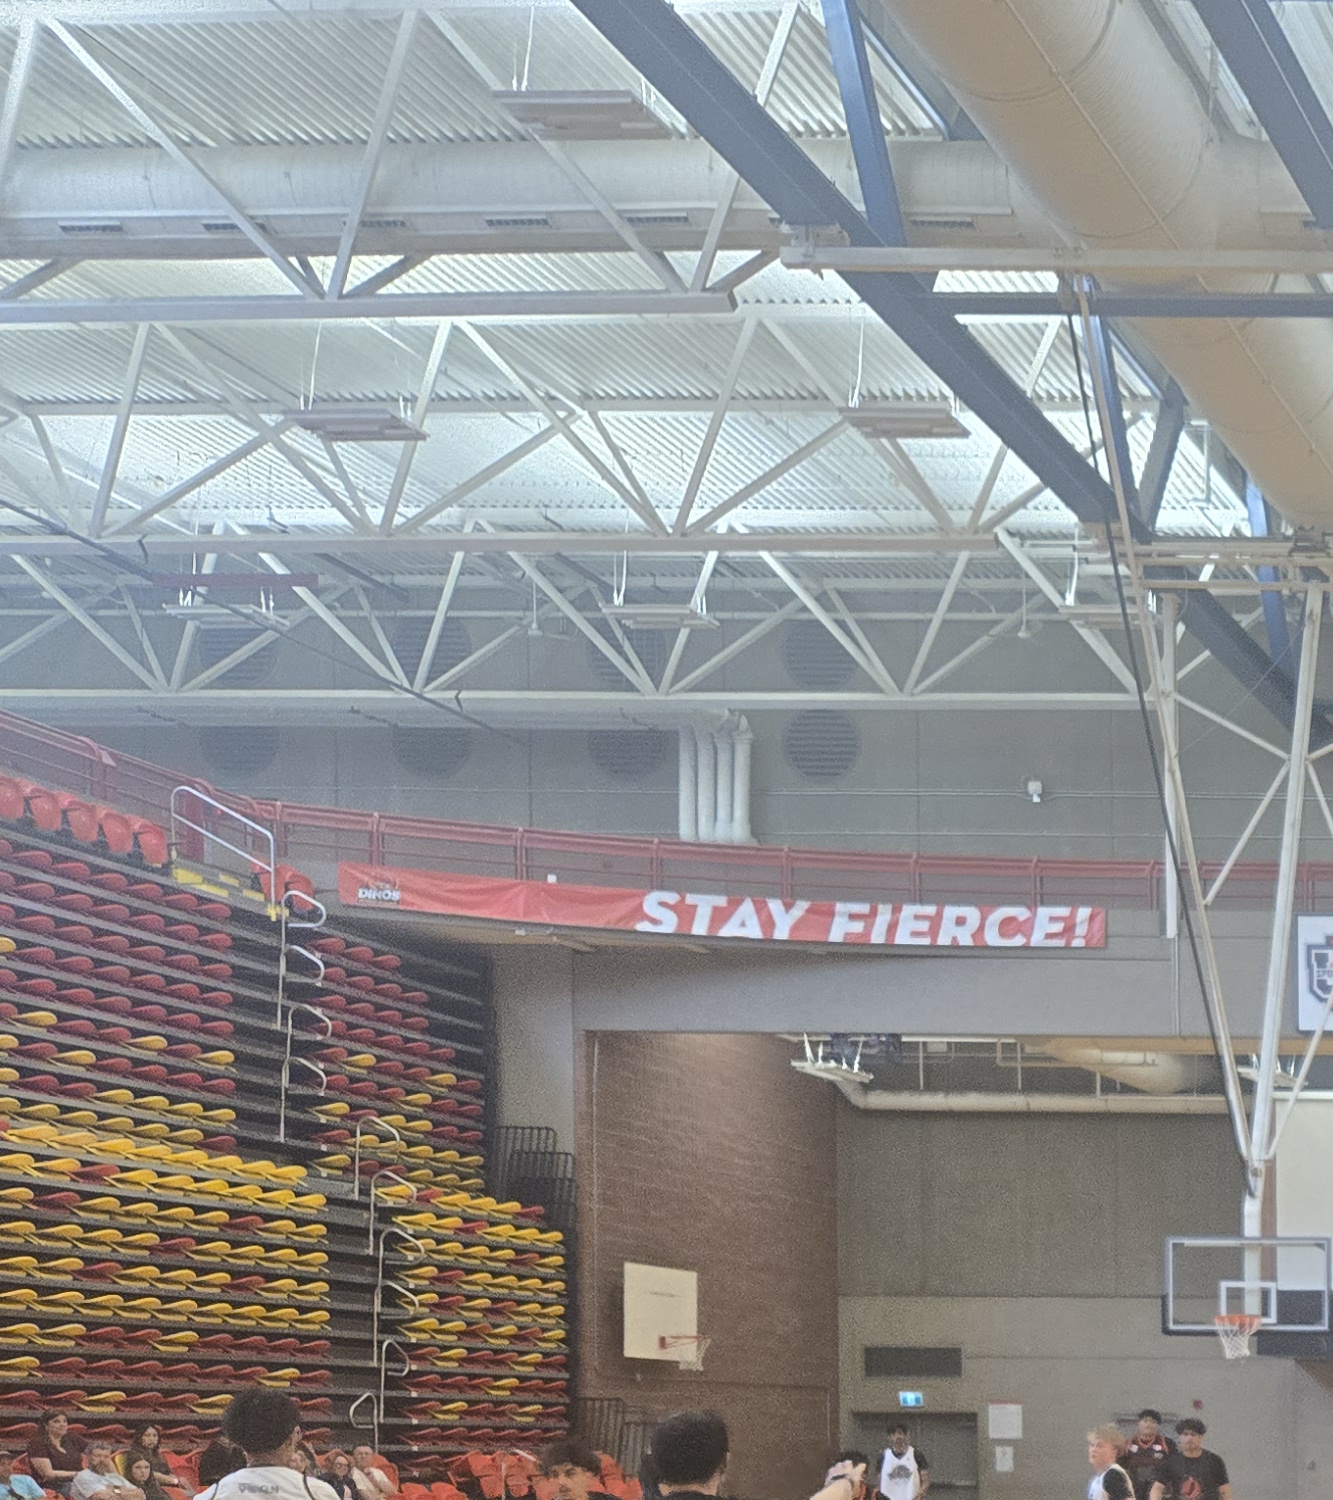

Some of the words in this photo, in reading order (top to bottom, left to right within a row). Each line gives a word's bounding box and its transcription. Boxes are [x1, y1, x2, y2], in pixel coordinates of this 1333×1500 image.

[357, 887, 400, 901] DINOS
[635, 890, 808, 940] STAY
[827, 901, 1094, 947] FIERCE!
